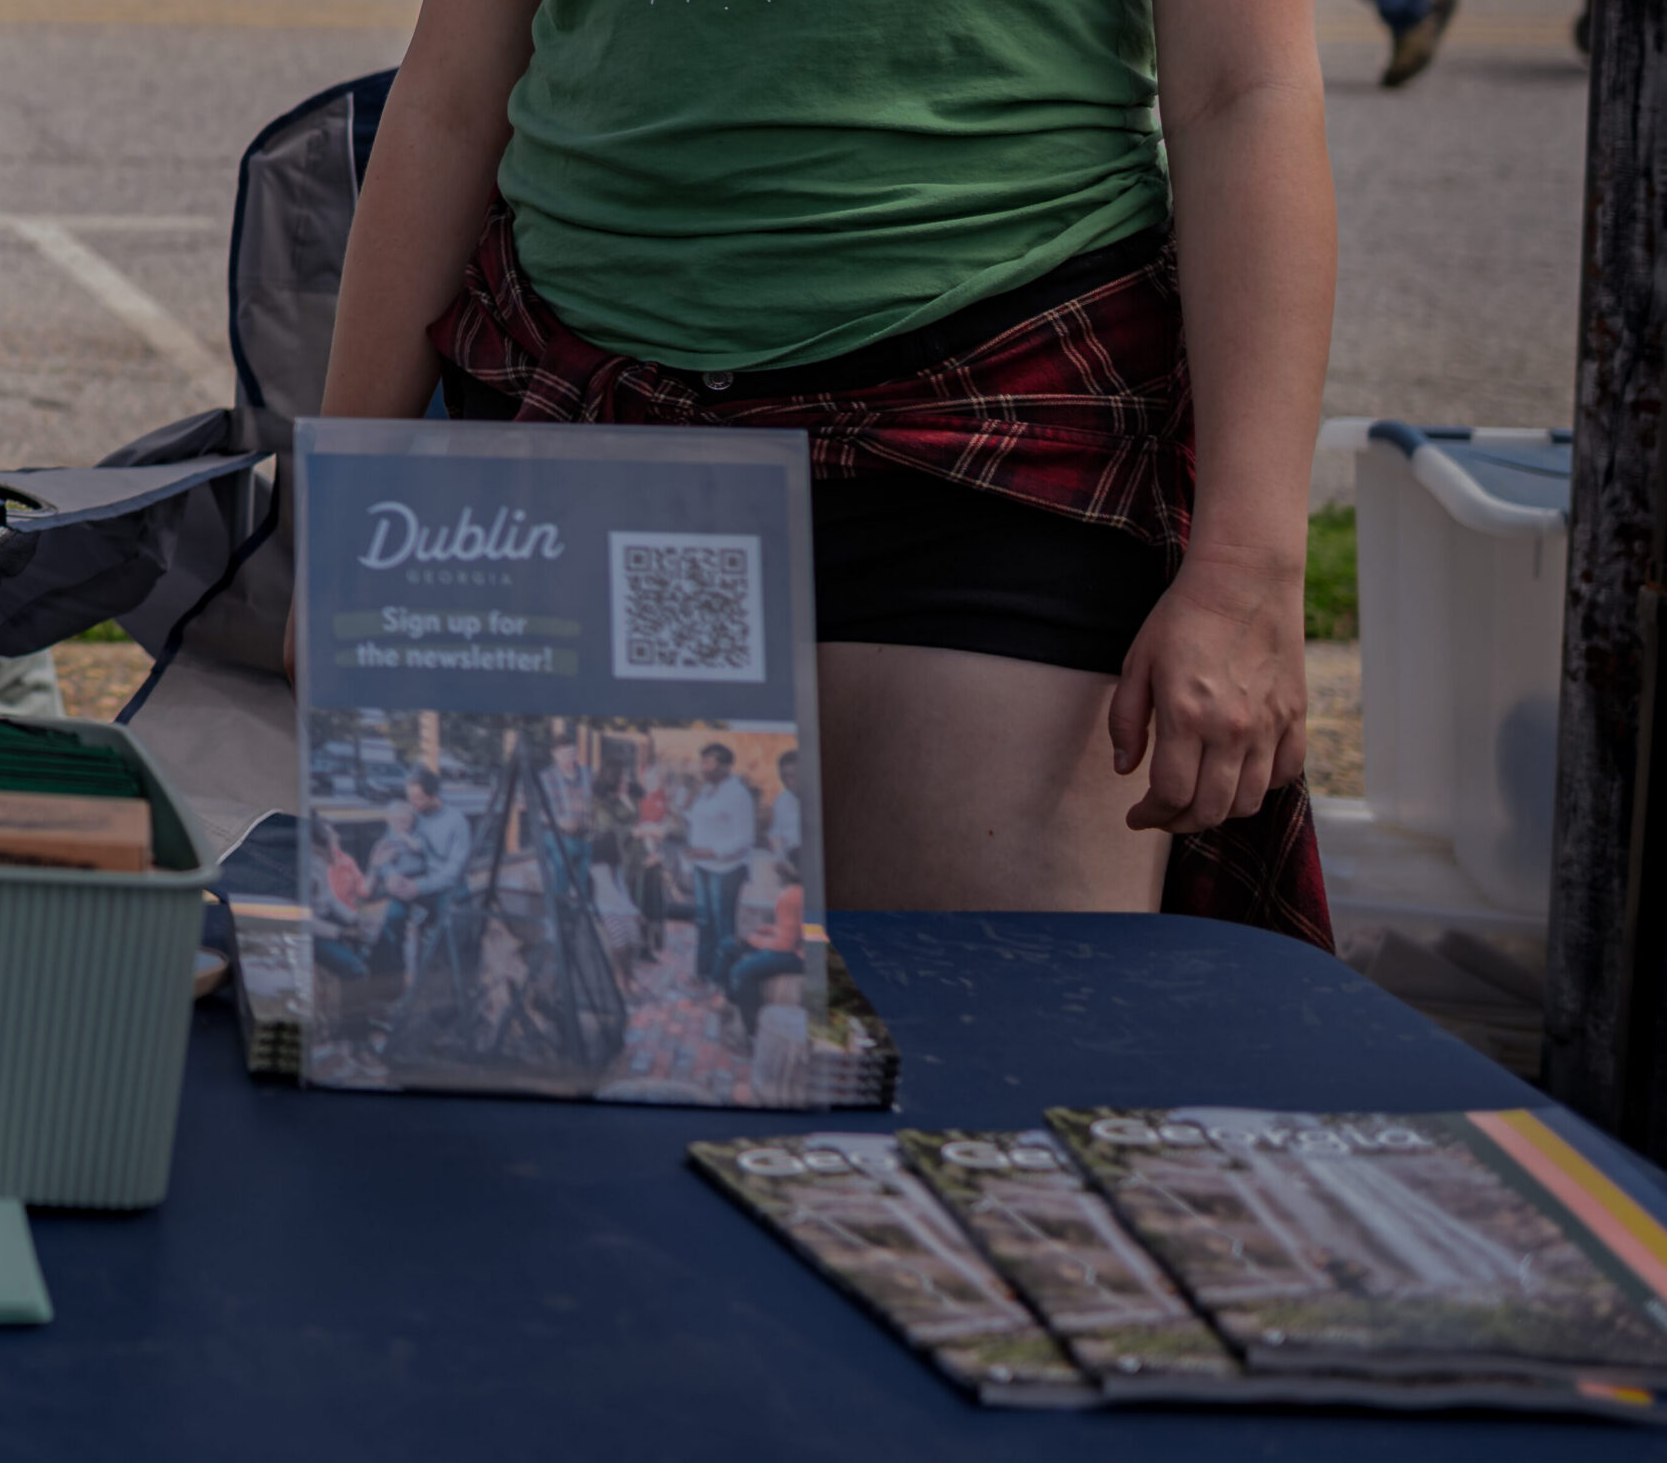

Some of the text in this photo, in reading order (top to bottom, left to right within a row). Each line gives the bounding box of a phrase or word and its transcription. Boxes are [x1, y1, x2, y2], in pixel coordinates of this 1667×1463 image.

[356, 500, 565, 571] Dublin
[405, 569, 514, 587] GEORGIA
[381, 605, 528, 641] Sign up for
[355, 641, 555, 673] the newsletter!
